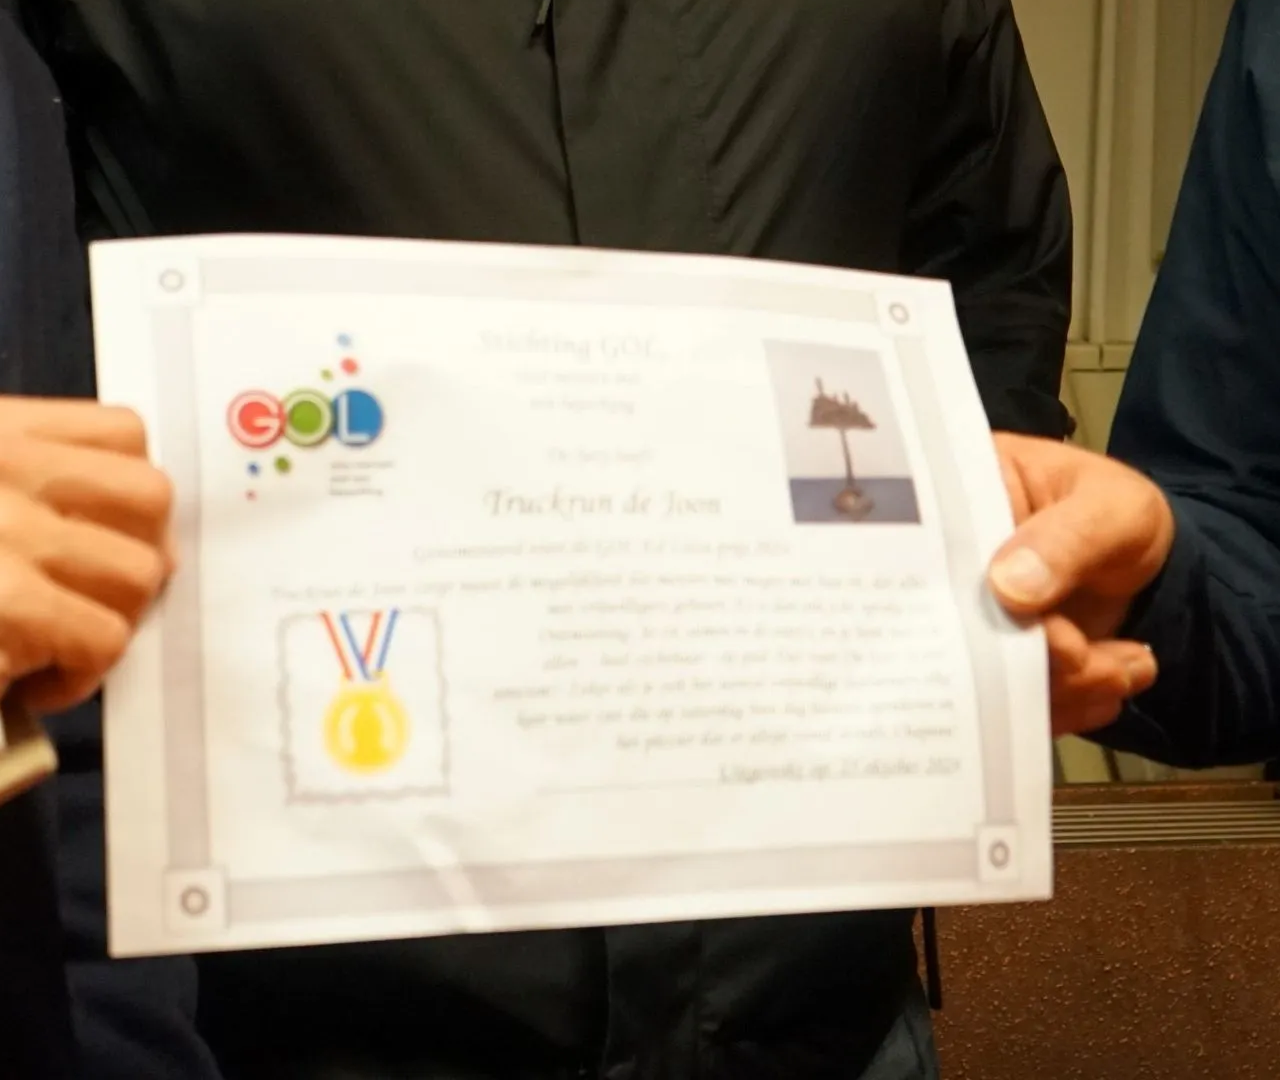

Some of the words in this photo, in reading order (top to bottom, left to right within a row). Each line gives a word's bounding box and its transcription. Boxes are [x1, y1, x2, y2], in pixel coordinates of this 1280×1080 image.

[227, 389, 376, 448] GOL
[481, 483, 613, 521] Truckrun
[622, 484, 652, 514] de
